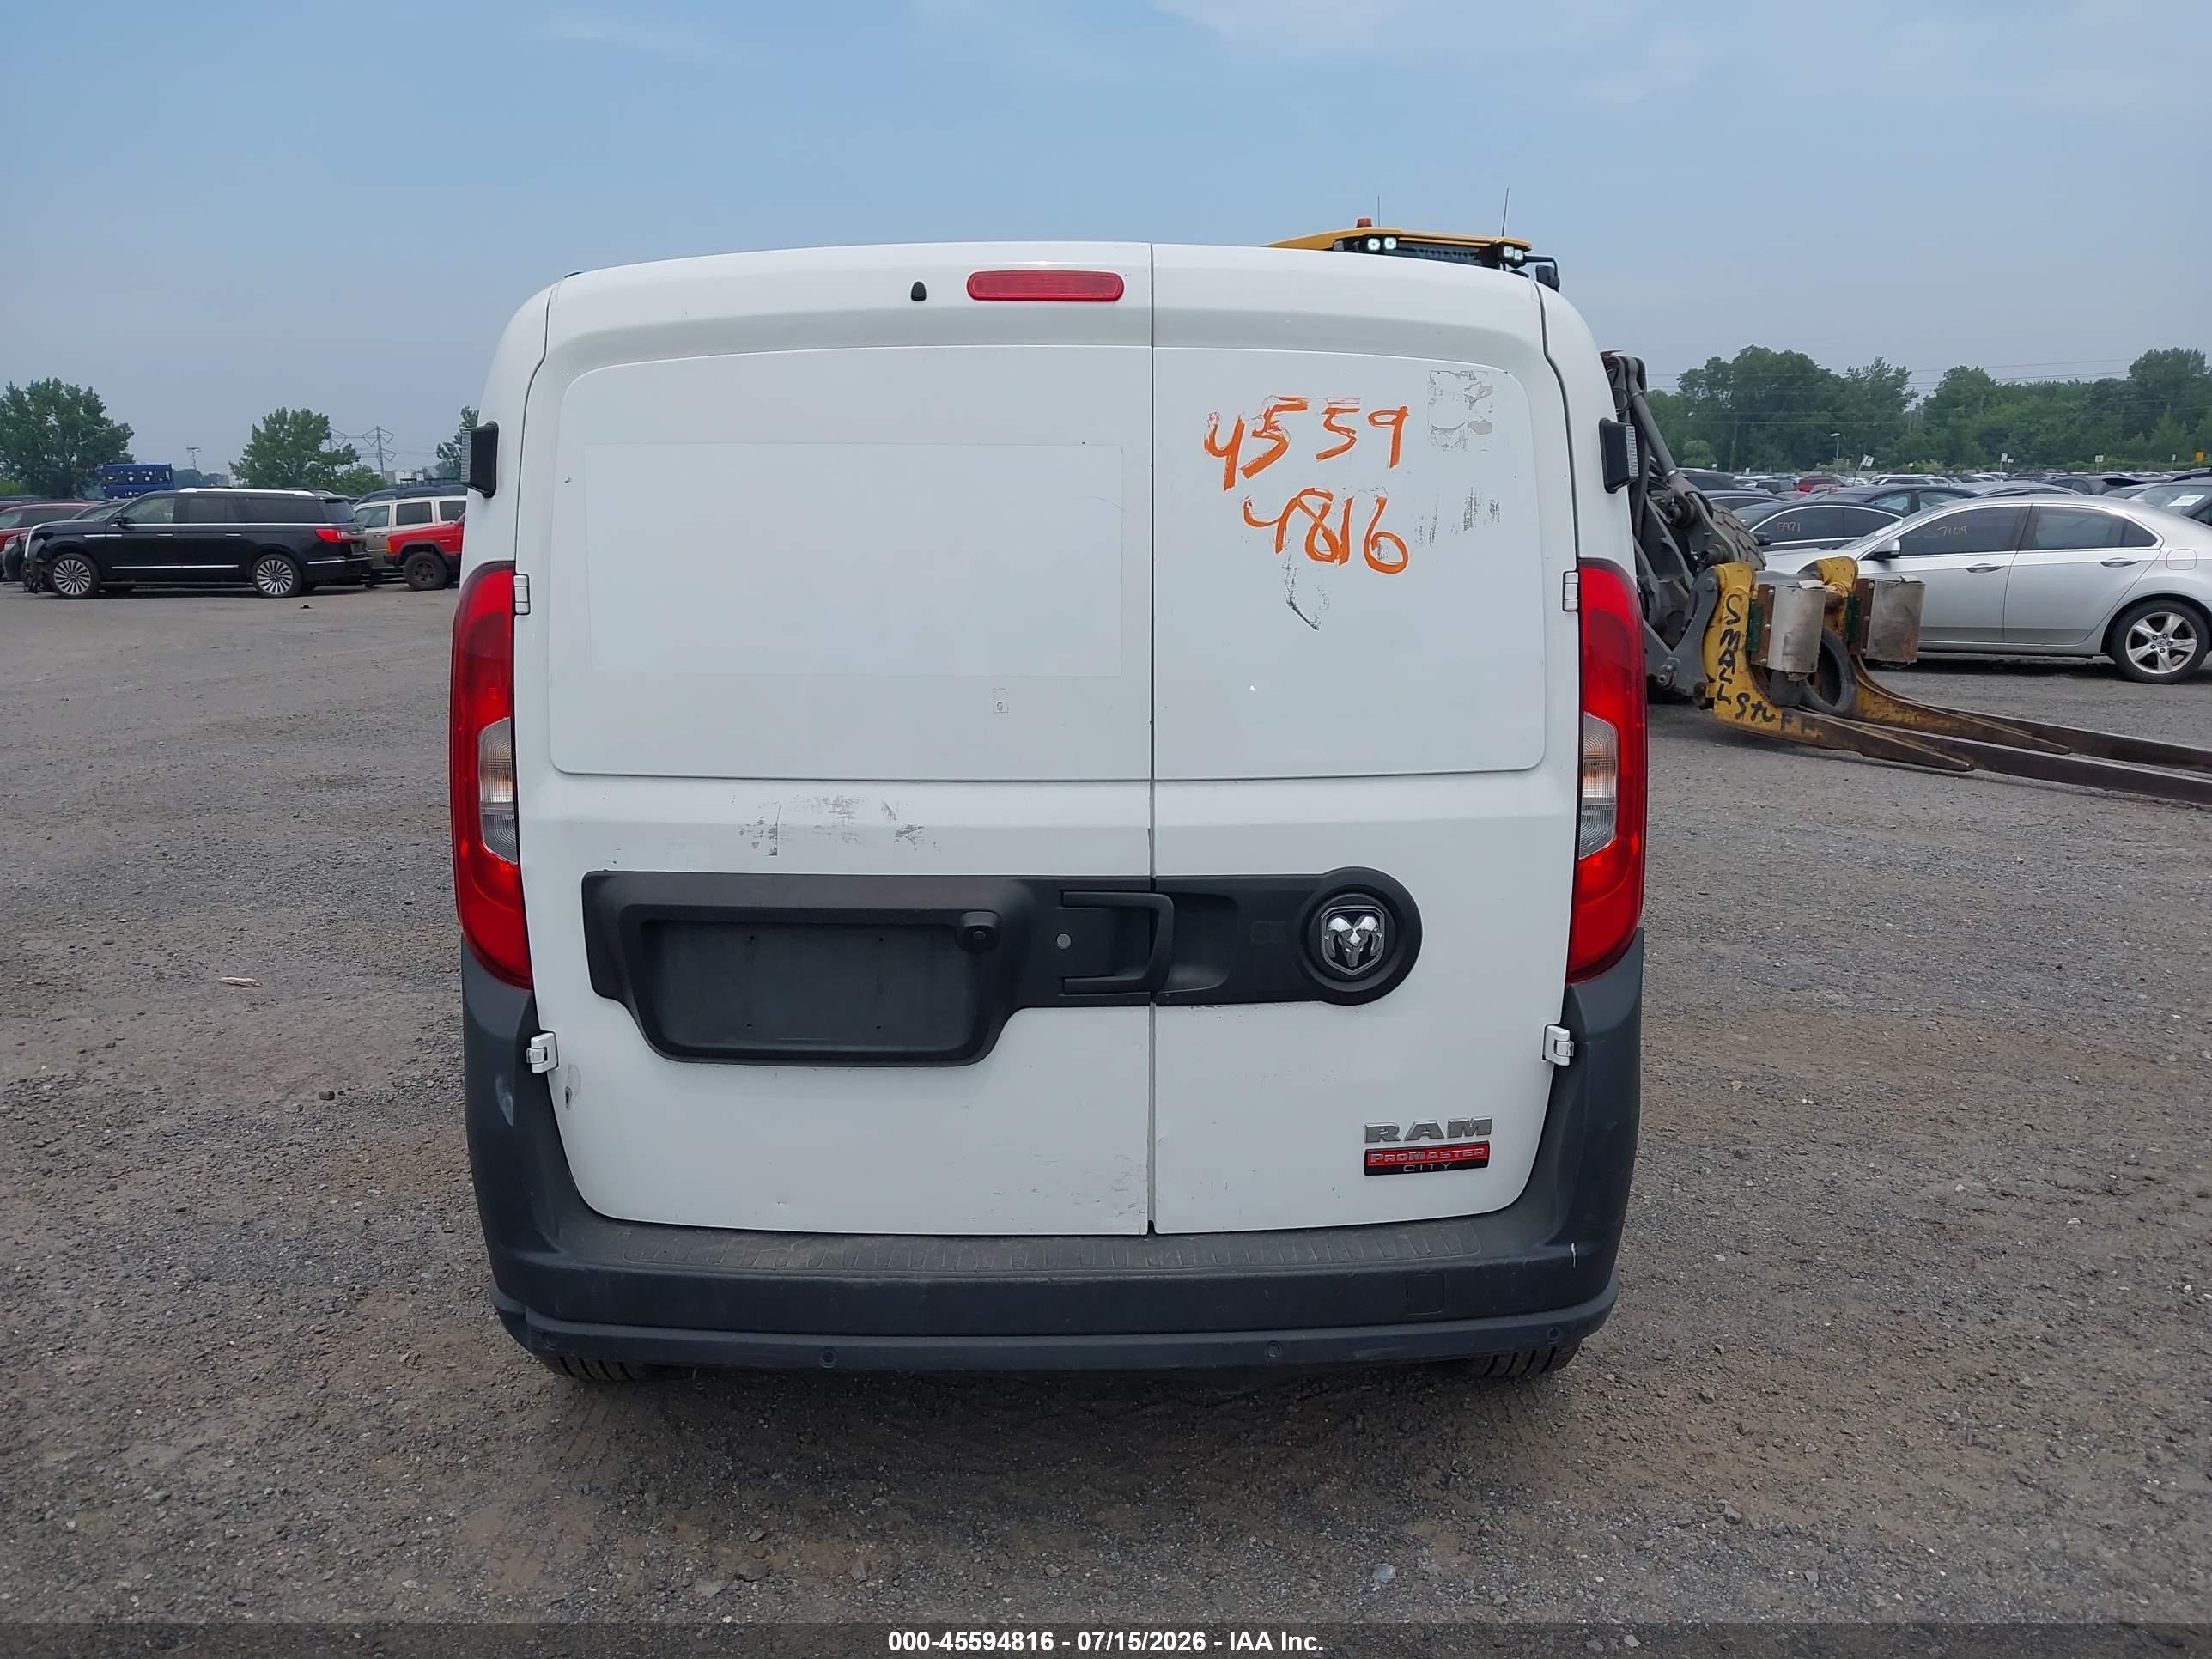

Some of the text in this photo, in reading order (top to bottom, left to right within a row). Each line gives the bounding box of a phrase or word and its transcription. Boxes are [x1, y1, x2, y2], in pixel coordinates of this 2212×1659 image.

[1204, 395, 1409, 491] 4559
[1243, 487, 1409, 574] 4816
[1717, 593, 1742, 705] SMALL
[1364, 1117, 1492, 1143] RAM
[1403, 1162, 1452, 1173] CITY
